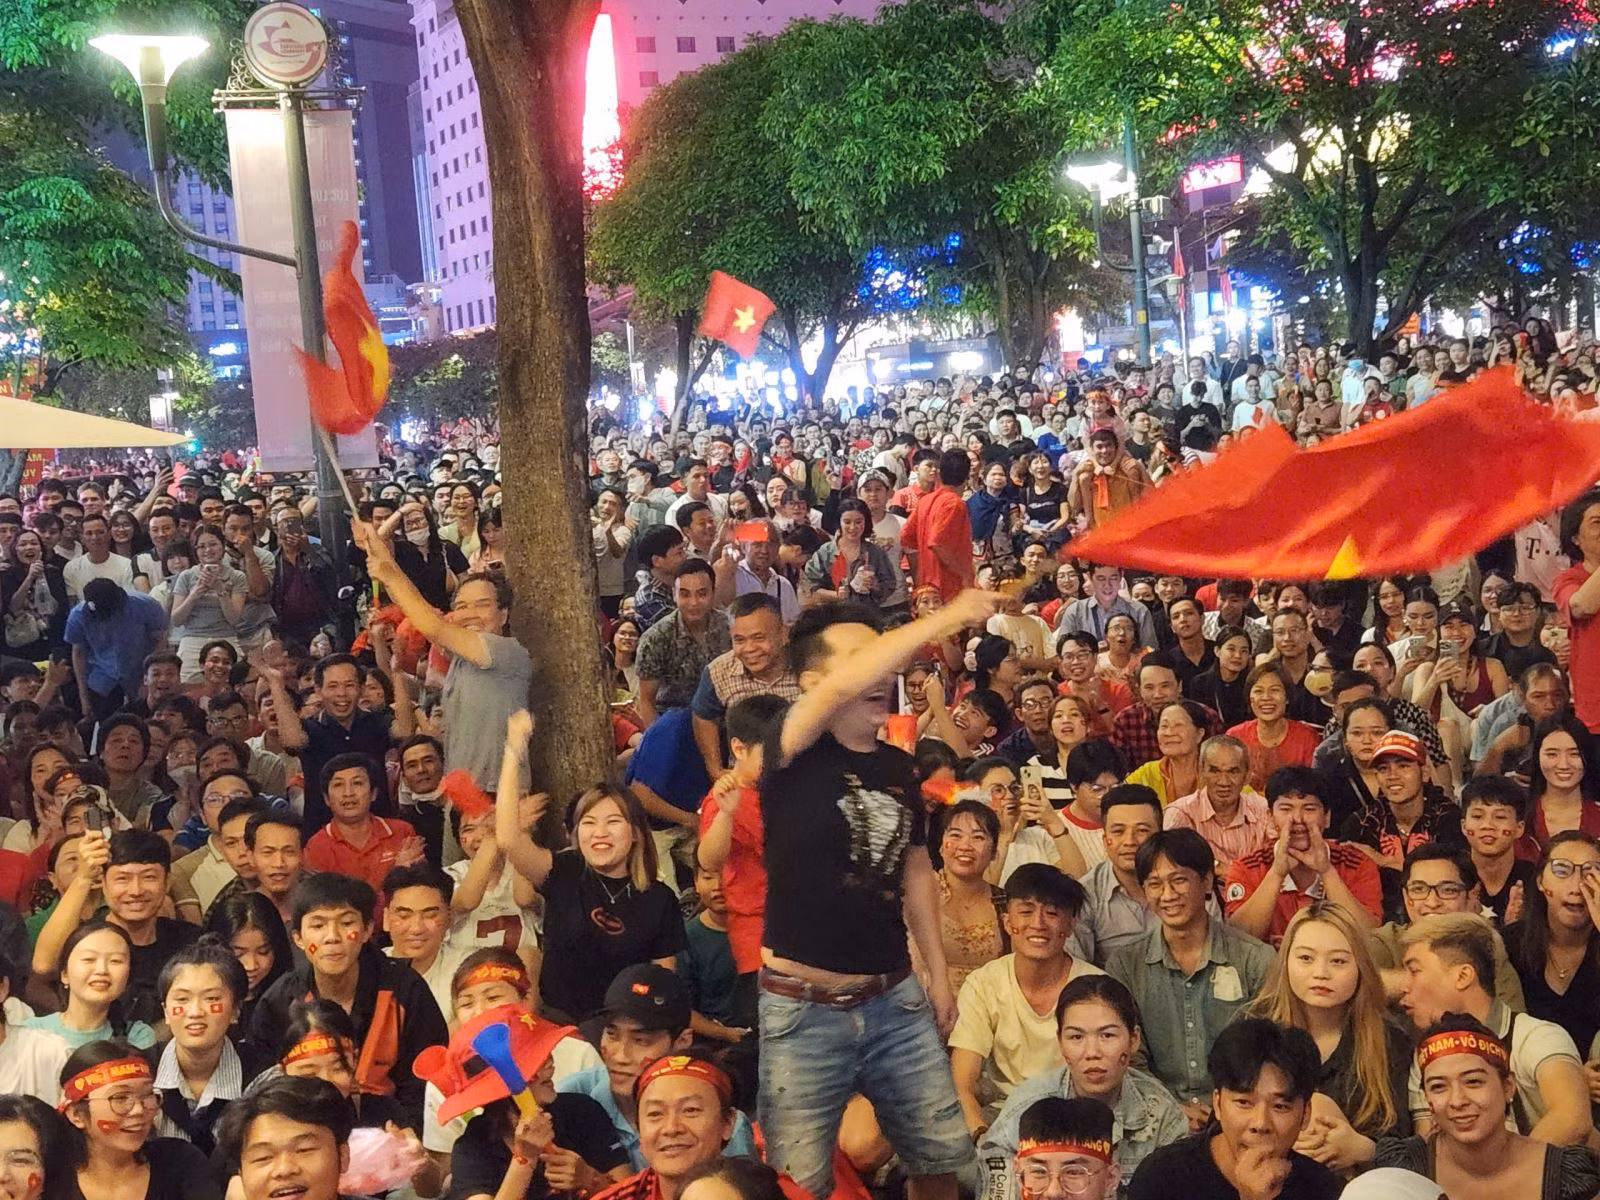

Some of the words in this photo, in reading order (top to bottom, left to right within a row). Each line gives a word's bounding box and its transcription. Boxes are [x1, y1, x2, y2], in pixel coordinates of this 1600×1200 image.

[476, 915, 523, 953] 7
[1428, 1037, 1455, 1055] NAM
[1460, 1035, 1477, 1048] VÔ
